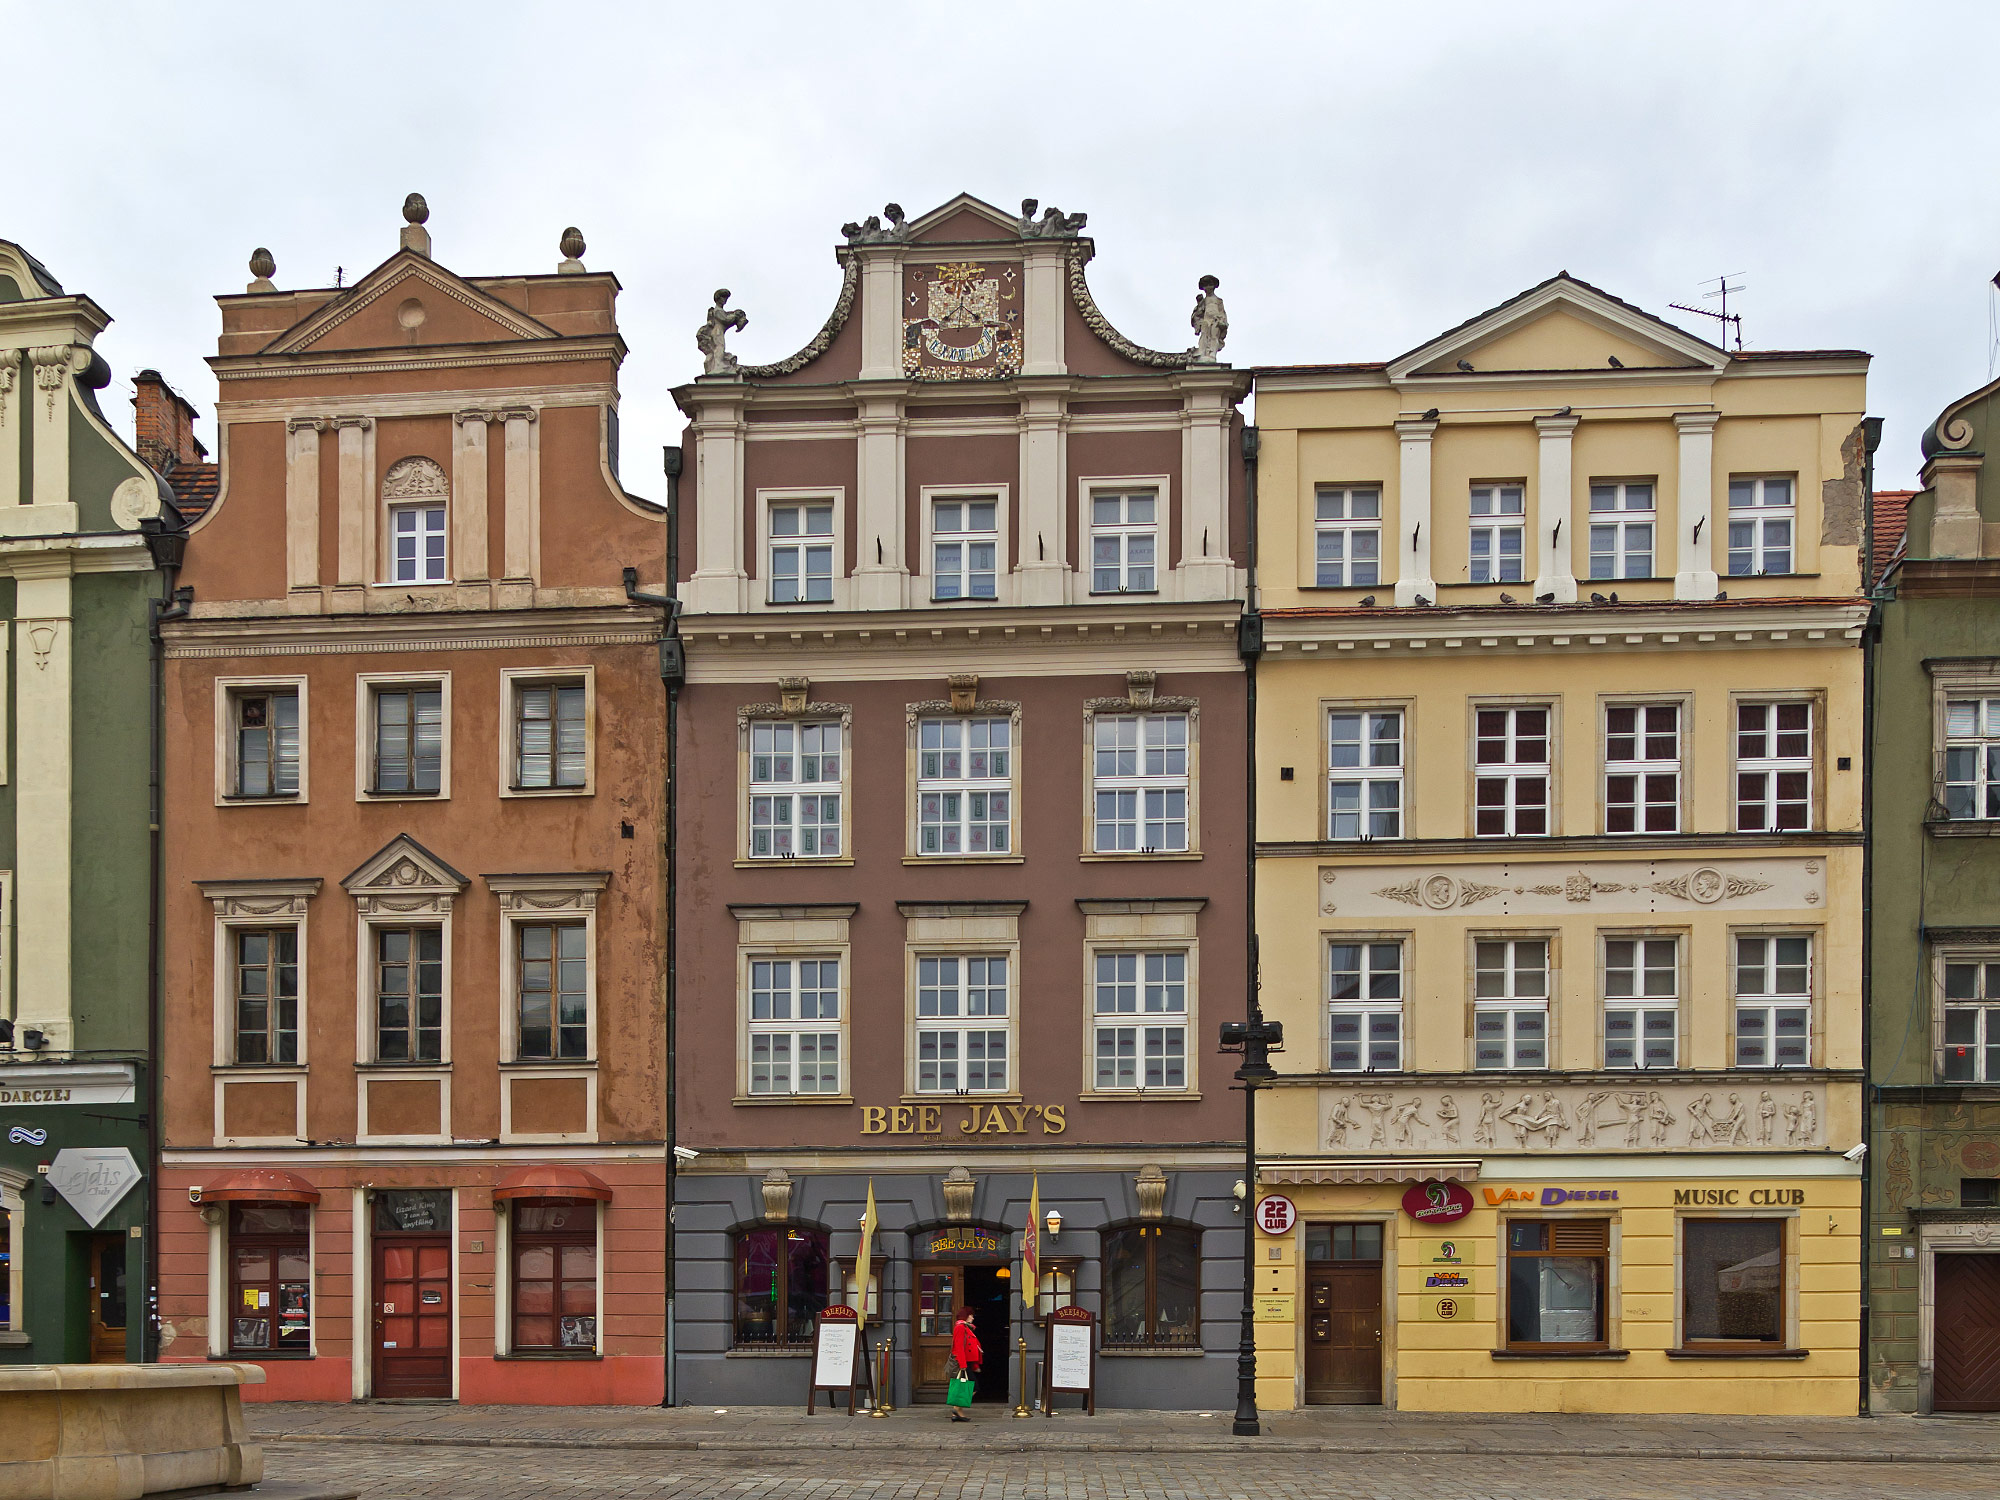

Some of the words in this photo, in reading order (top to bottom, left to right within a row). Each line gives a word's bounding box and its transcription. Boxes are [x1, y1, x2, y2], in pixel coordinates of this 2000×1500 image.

[0, 1089, 72, 1103] DARCZEJ
[859, 1105, 942, 1134] BEE
[959, 1104, 1066, 1134] JAY'S
[56, 1162, 121, 1196] Lejdis
[88, 1186, 110, 1196] Club
[1482, 1187, 1535, 1205] VAN
[1674, 1189, 1739, 1205] MUSIC
[1749, 1189, 1805, 1205] CLUB
[1265, 1201, 1287, 1219] 22
[1265, 1219, 1287, 1229] CLUB
[930, 1237, 956, 1253] BEE
[1441, 1302, 1453, 1310] 22
